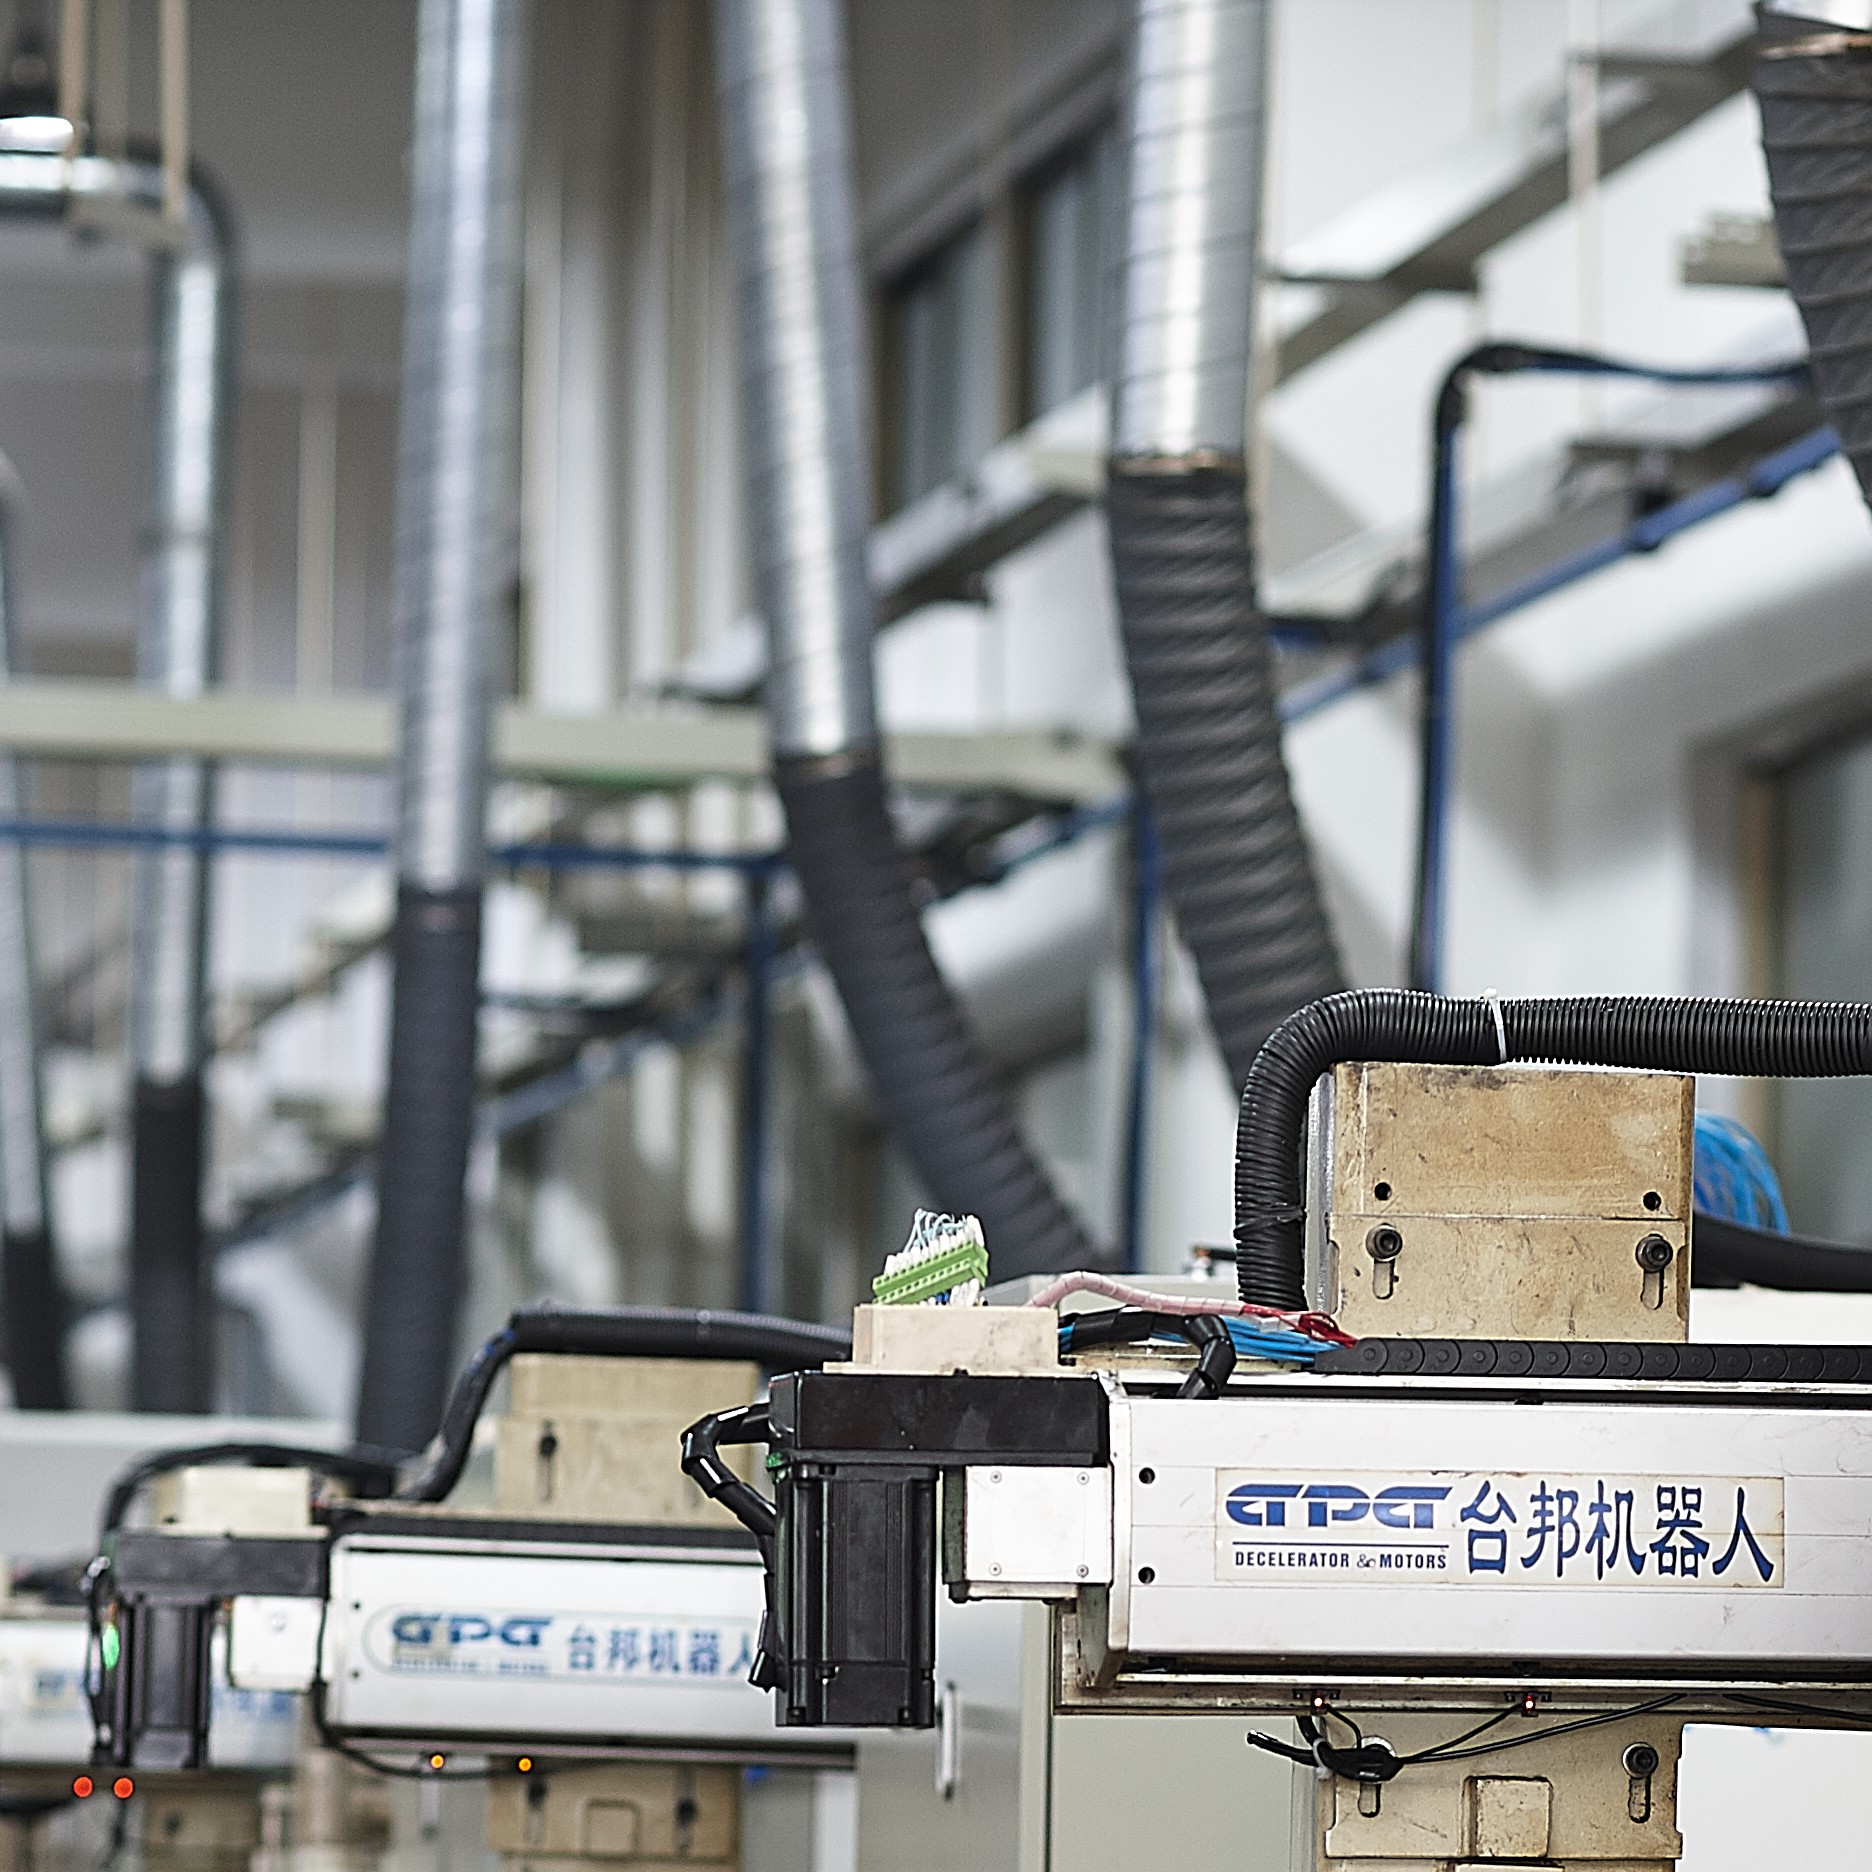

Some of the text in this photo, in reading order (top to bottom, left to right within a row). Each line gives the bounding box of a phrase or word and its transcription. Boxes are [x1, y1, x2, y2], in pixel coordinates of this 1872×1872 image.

[1234, 1550, 1350, 1568] DECELERATOR
[1379, 1553, 1447, 1569] MOTORS
[1460, 1479, 1775, 1582] 台邦机器人
